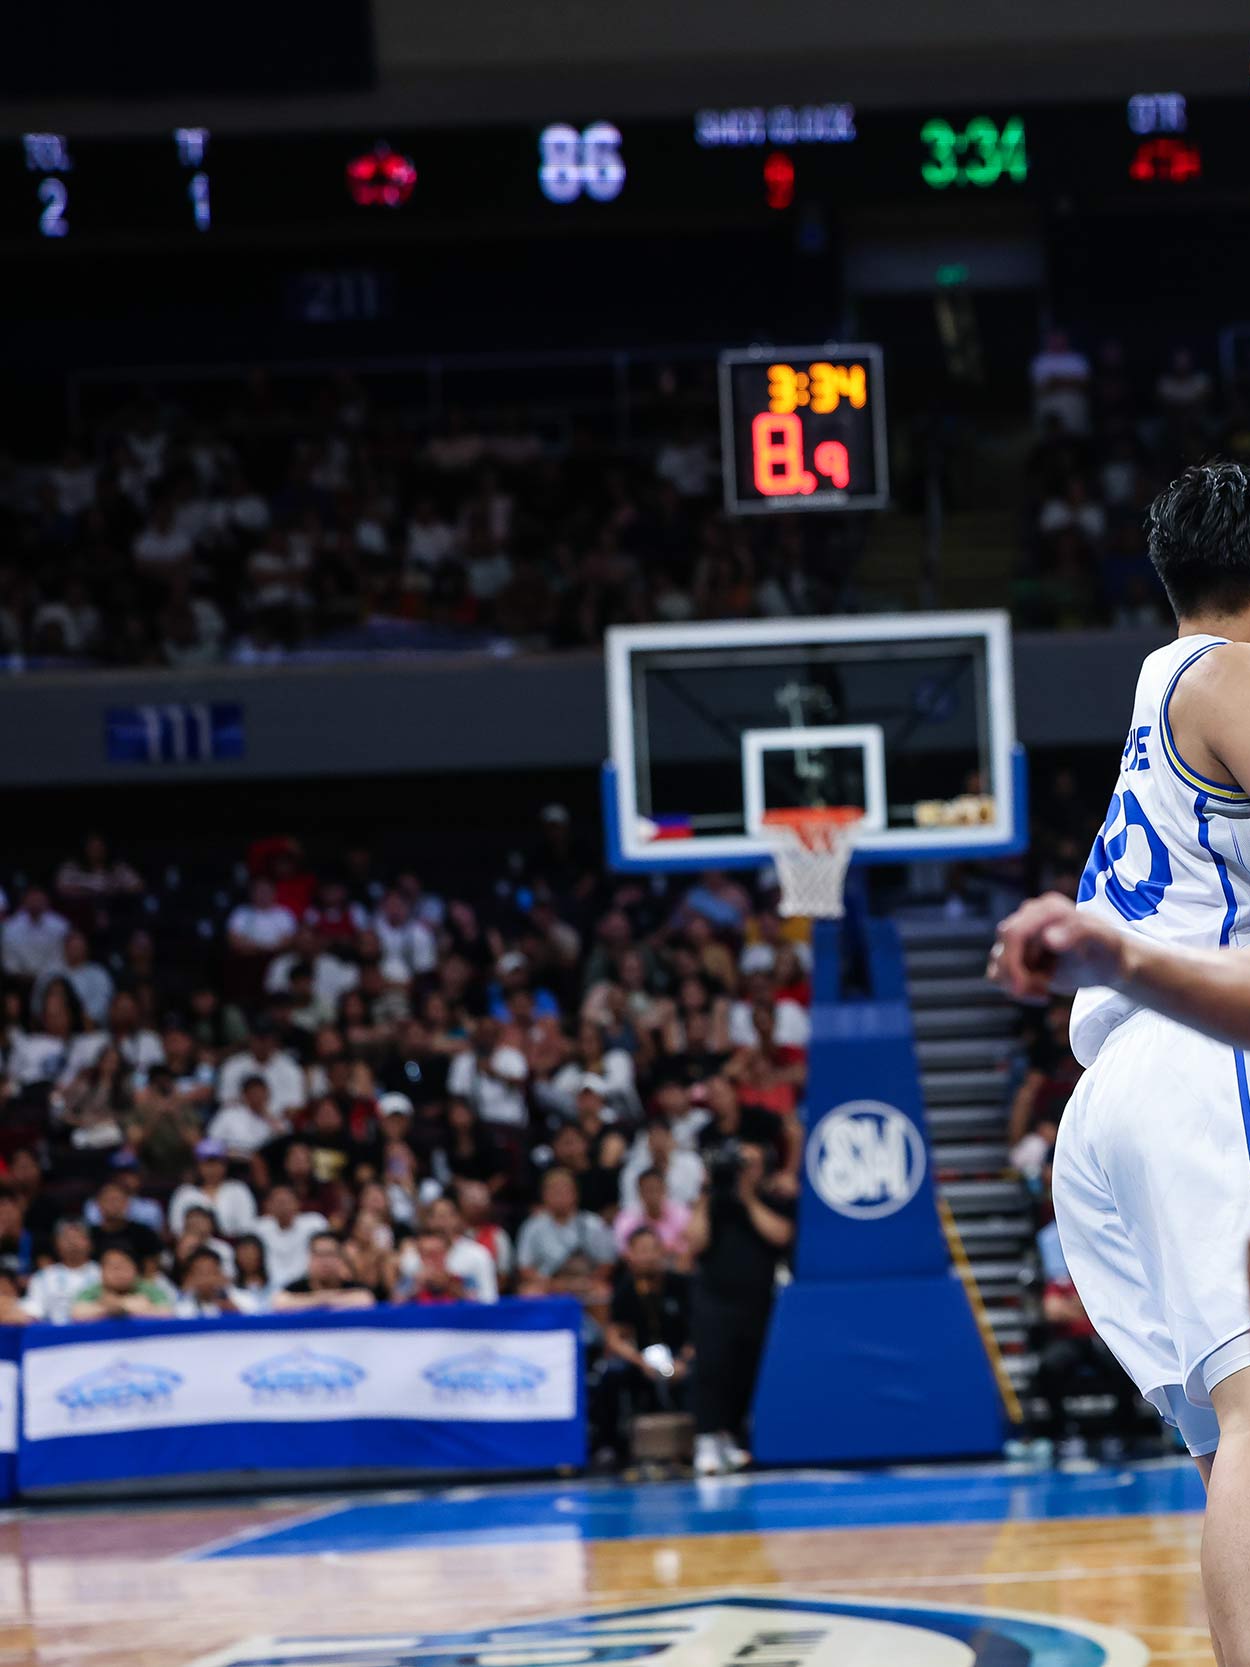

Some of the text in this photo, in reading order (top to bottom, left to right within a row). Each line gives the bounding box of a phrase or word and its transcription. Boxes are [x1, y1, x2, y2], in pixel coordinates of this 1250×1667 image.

[920, 115, 1029, 190] 3:34
[37, 176, 69, 237] 2
[189, 170, 211, 232] 1
[766, 362, 868, 415] 3:34
[820, 1114, 909, 1204] SM
